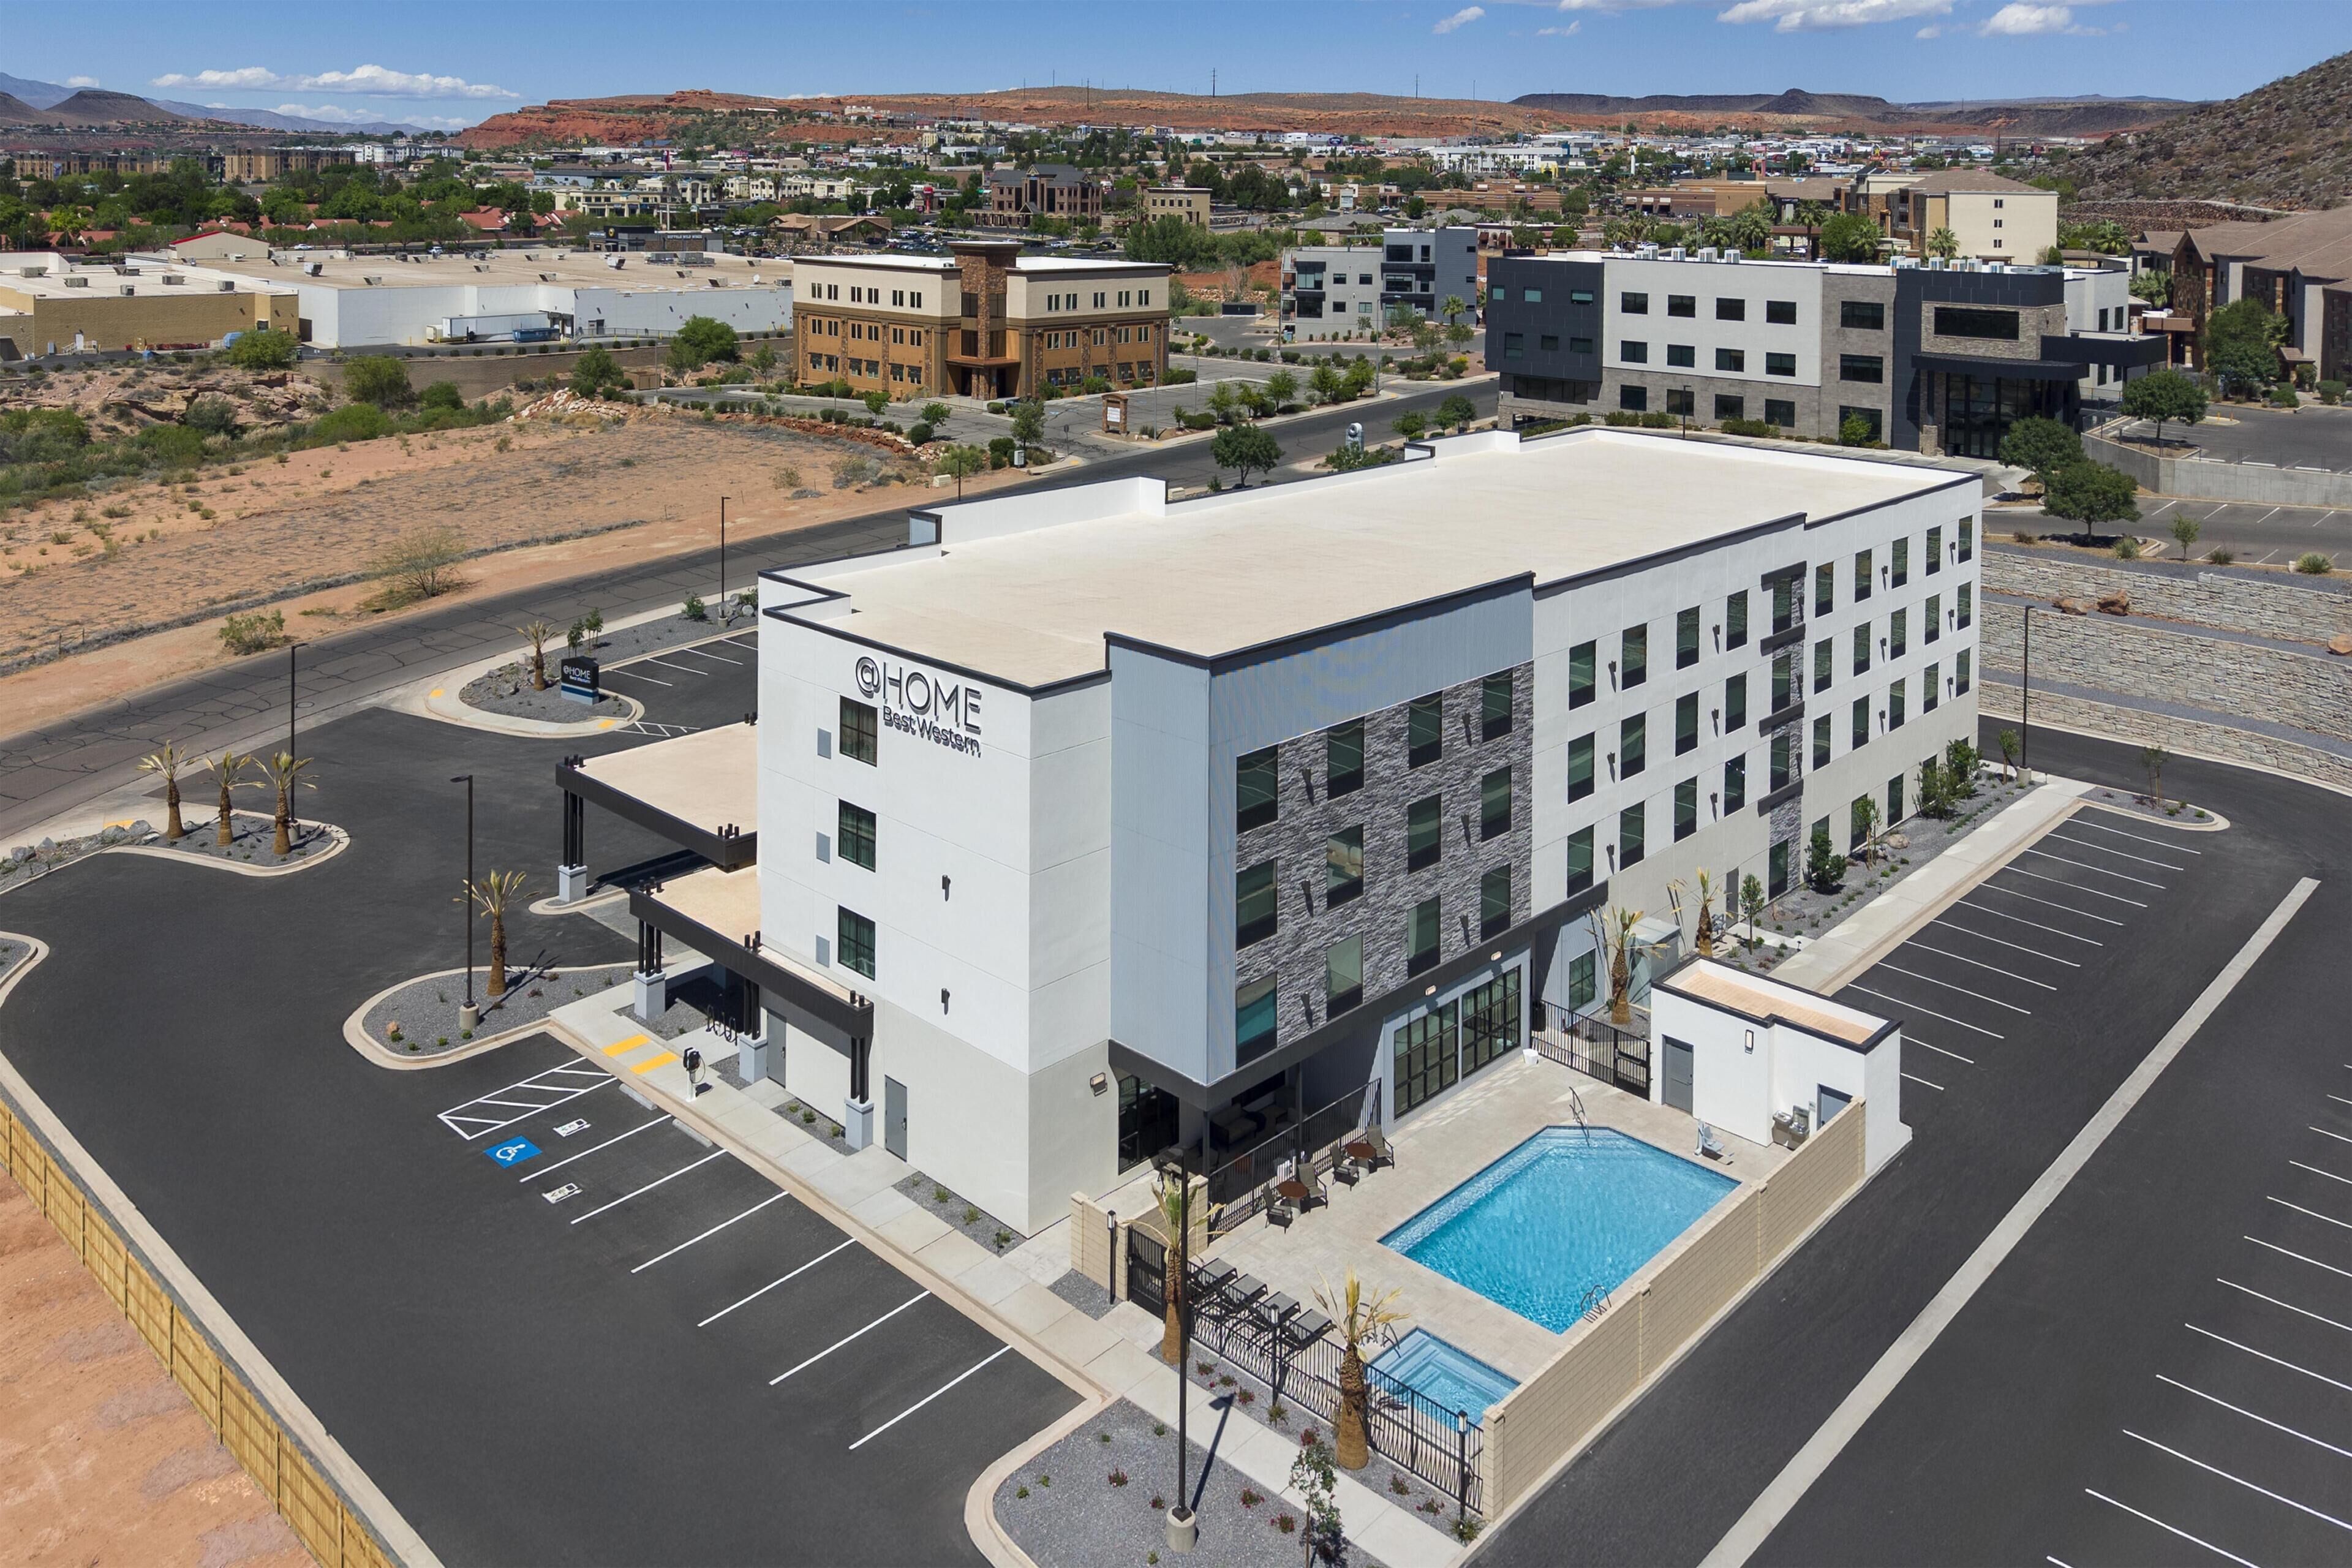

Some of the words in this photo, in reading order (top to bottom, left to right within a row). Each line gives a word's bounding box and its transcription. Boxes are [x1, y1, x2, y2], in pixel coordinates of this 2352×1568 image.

[563, 665, 591, 680] @HOME
[856, 656, 981, 731] @HOME
[883, 705, 914, 731] Best
[917, 716, 979, 753] Western
